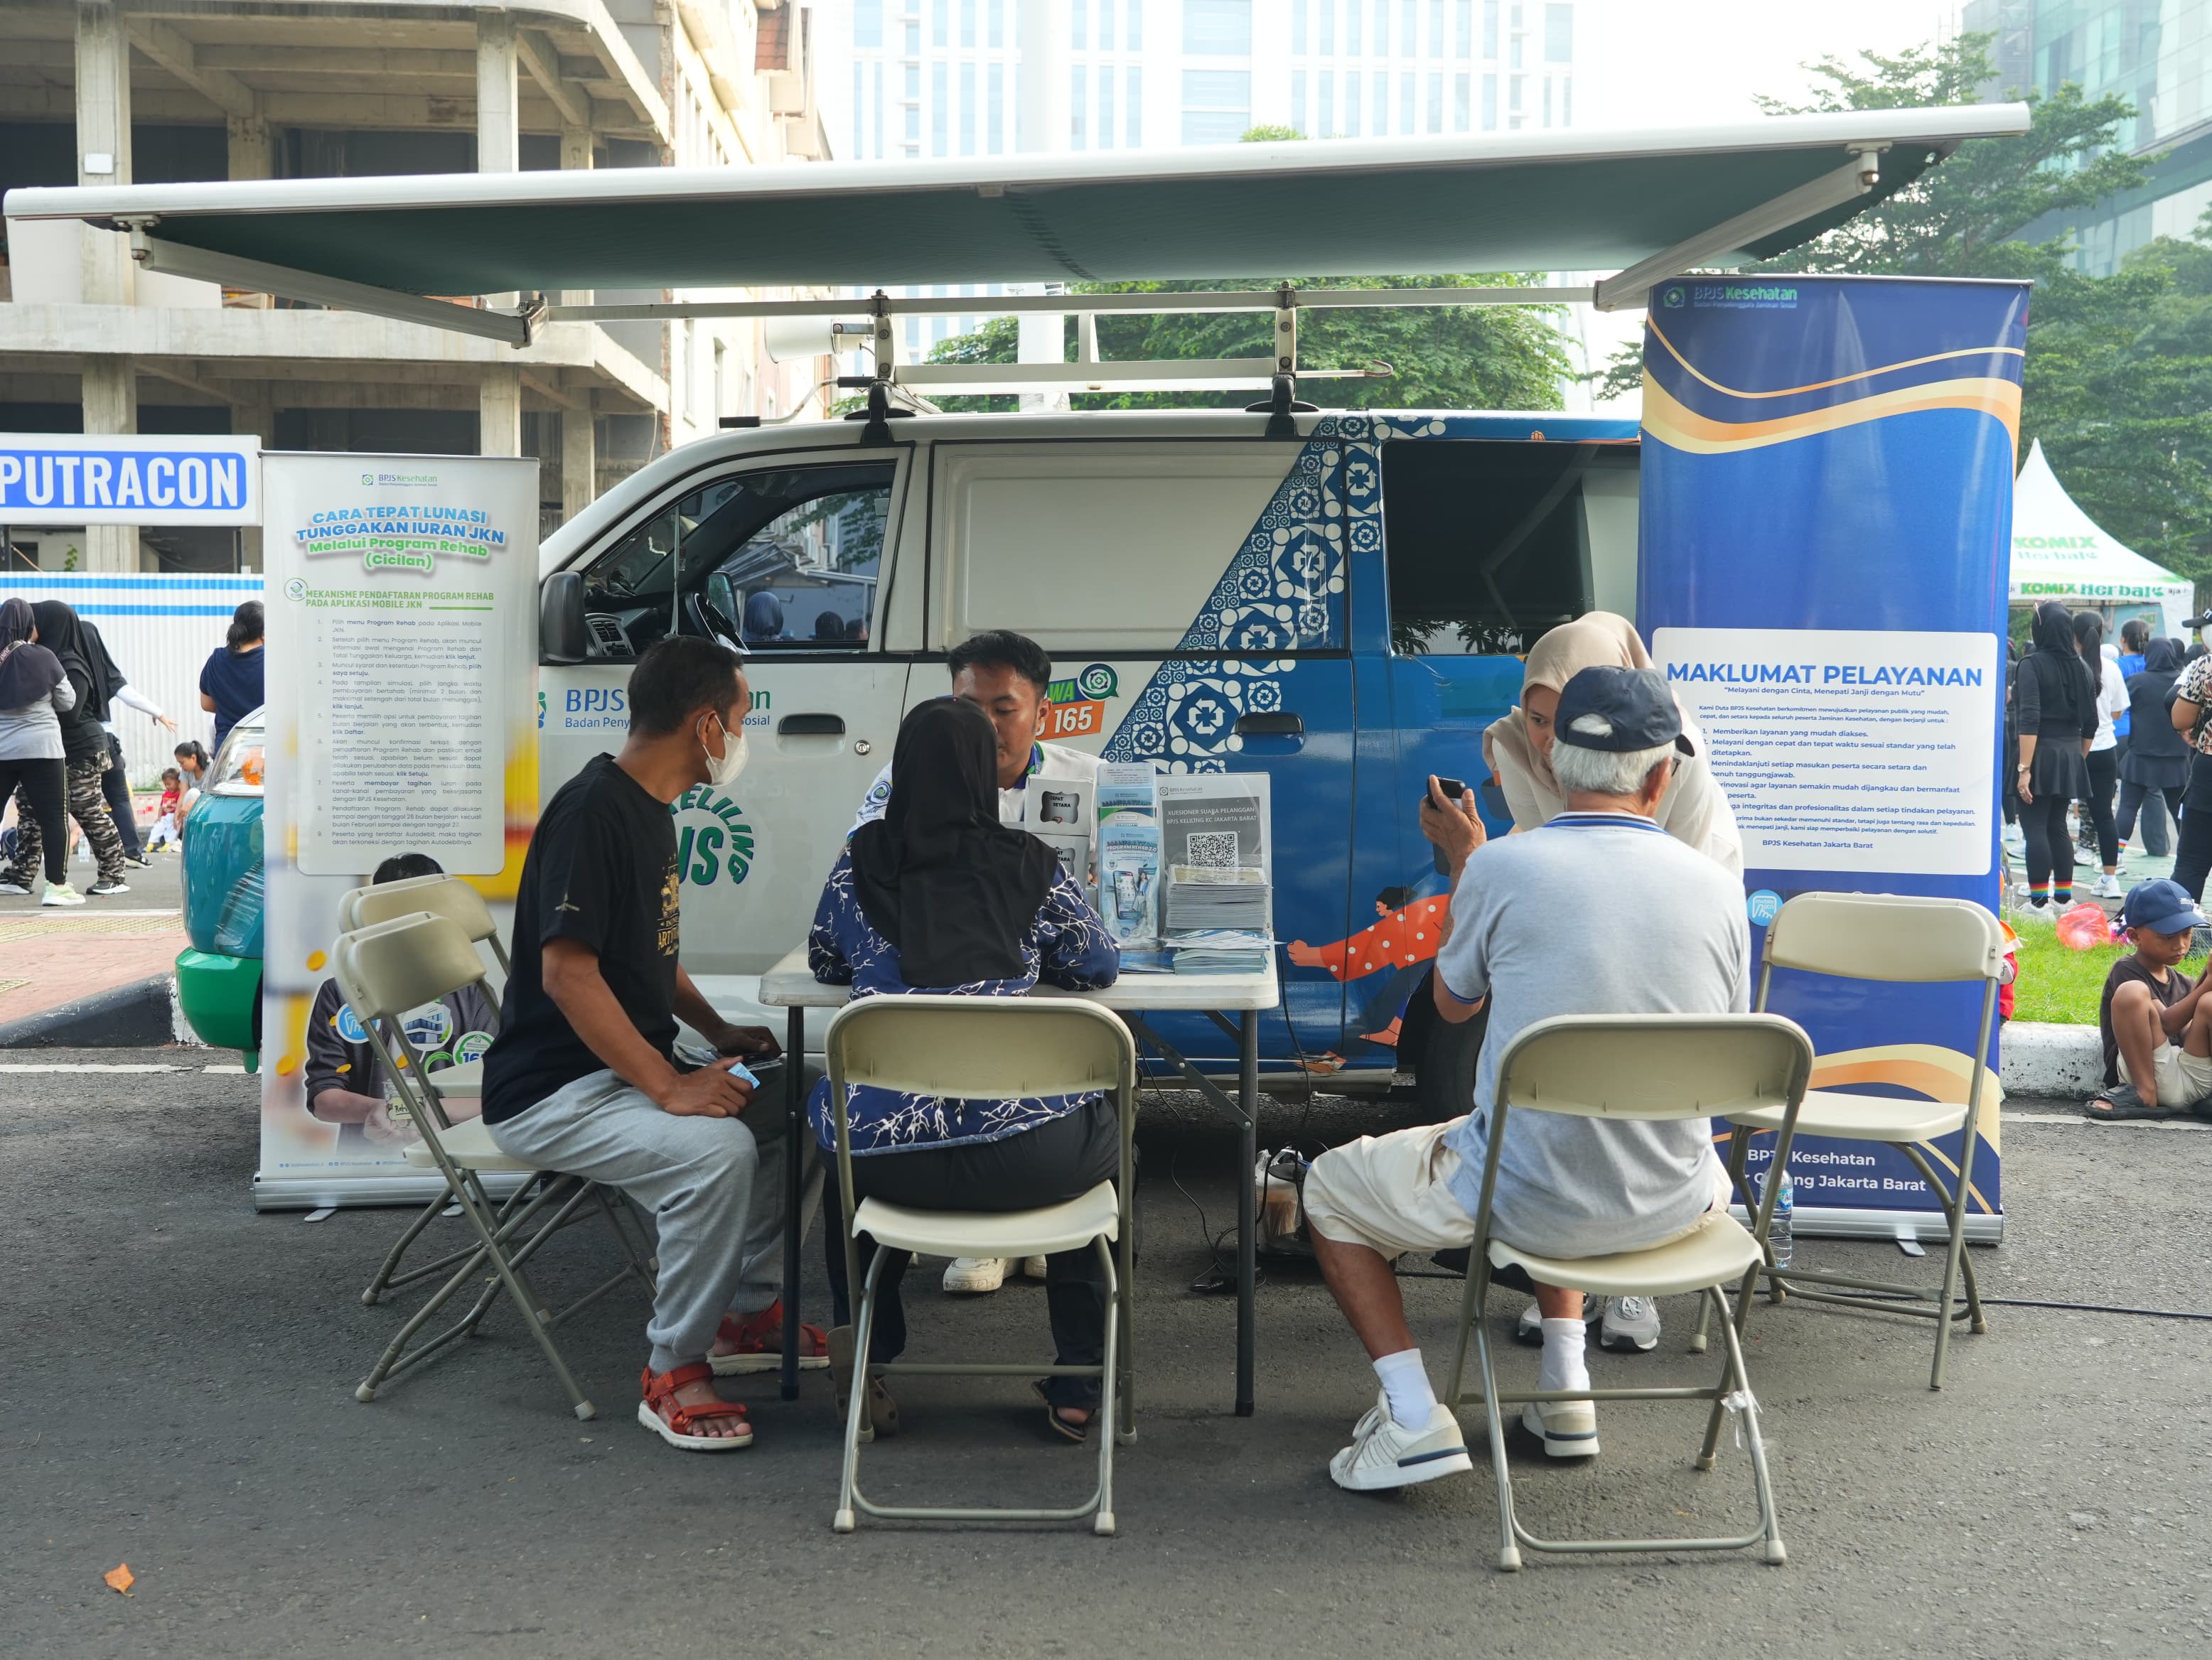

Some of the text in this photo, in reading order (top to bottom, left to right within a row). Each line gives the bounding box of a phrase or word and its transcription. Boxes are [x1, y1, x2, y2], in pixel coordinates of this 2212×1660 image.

[1695, 286, 1798, 300] BPJS Kesehatan
[0, 455, 239, 507] PUTRACON
[312, 506, 486, 524] CARA TEPAT LUNASI
[296, 522, 504, 543] TUNGGAKAN IURAN JKN
[309, 538, 488, 556] Melalui Program Rehab
[2014, 537, 2098, 549] KOMIX
[365, 553, 433, 569] (Cicilan)
[2018, 551, 2085, 560] Herbal
[306, 590, 357, 598] MEKANISME
[360, 591, 420, 600] PENDAFTARAN
[466, 593, 493, 601] REHAB
[2021, 583, 2077, 595] KOMIX
[2080, 584, 2150, 598] Herbal
[306, 600, 422, 609] PADA APLIKASI MOBILE JKN
[1668, 662, 1982, 686] MAKLUMAT PELAYANAN
[1049, 681, 1074, 703] WA
[567, 689, 624, 712] BPJS
[565, 717, 600, 728] Badan
[1055, 705, 1093, 733] 165
[1791, 1151, 1875, 1166] Kesehatan
[1818, 1175, 1878, 1190] Jakarta
[1884, 1178, 1926, 1191] Barat
